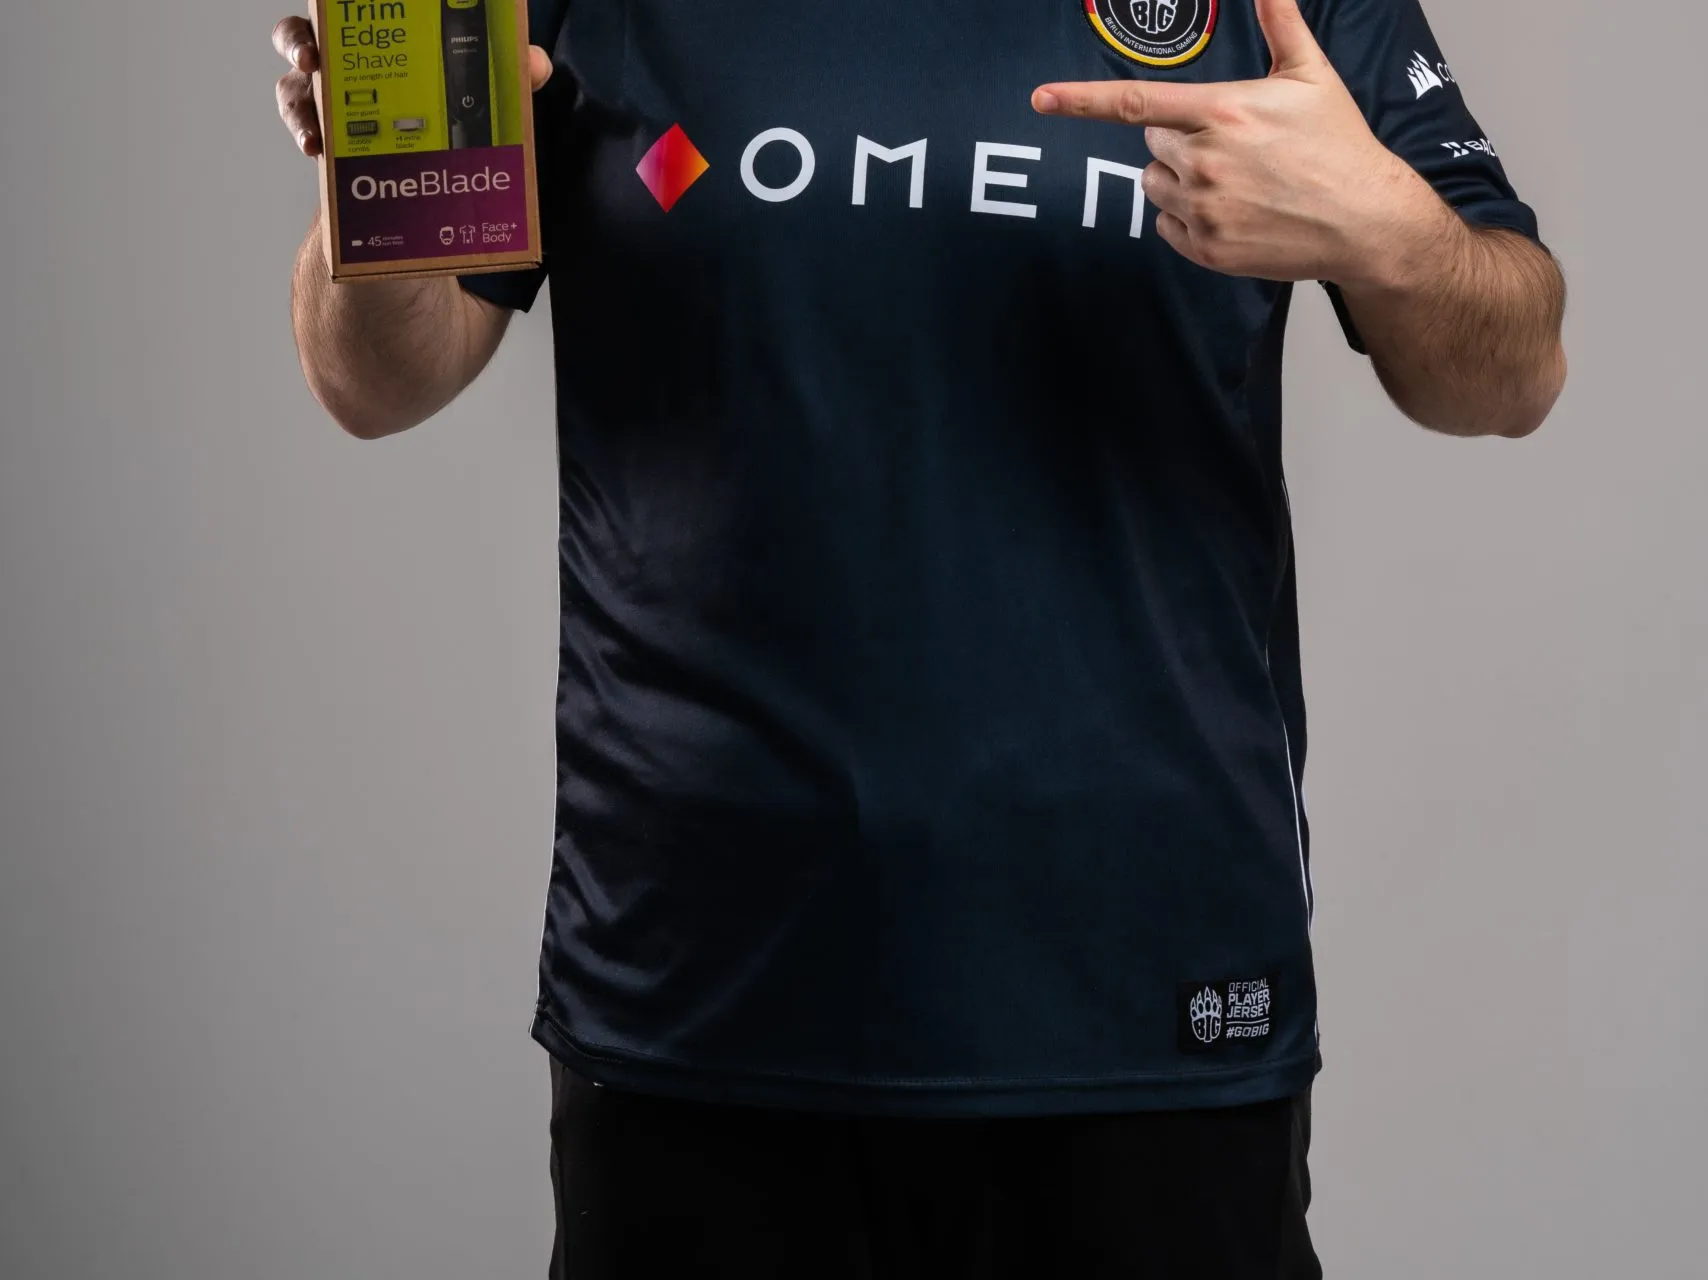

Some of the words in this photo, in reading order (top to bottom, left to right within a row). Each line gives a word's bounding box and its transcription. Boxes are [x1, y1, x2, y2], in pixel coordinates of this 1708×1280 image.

[341, 24, 407, 49] Edge
[451, 36, 479, 44] PHILIPS
[1104, 16, 1124, 39] BERLIN
[1123, 37, 1175, 55] INTERNATIONAL
[1175, 31, 1198, 51] GAMING
[342, 52, 408, 71] Shave
[360, 73, 384, 81] length
[351, 166, 511, 201] OneBlade
[739, 126, 1147, 239] OMEN
[367, 236, 382, 247] 45
[482, 232, 512, 244] Body
[1228, 978, 1269, 993] OFFICIAL
[1228, 988, 1270, 1006] PLAYER
[1226, 1001, 1271, 1018] JERSEY
[1226, 1023, 1270, 1039] #GOBIG
